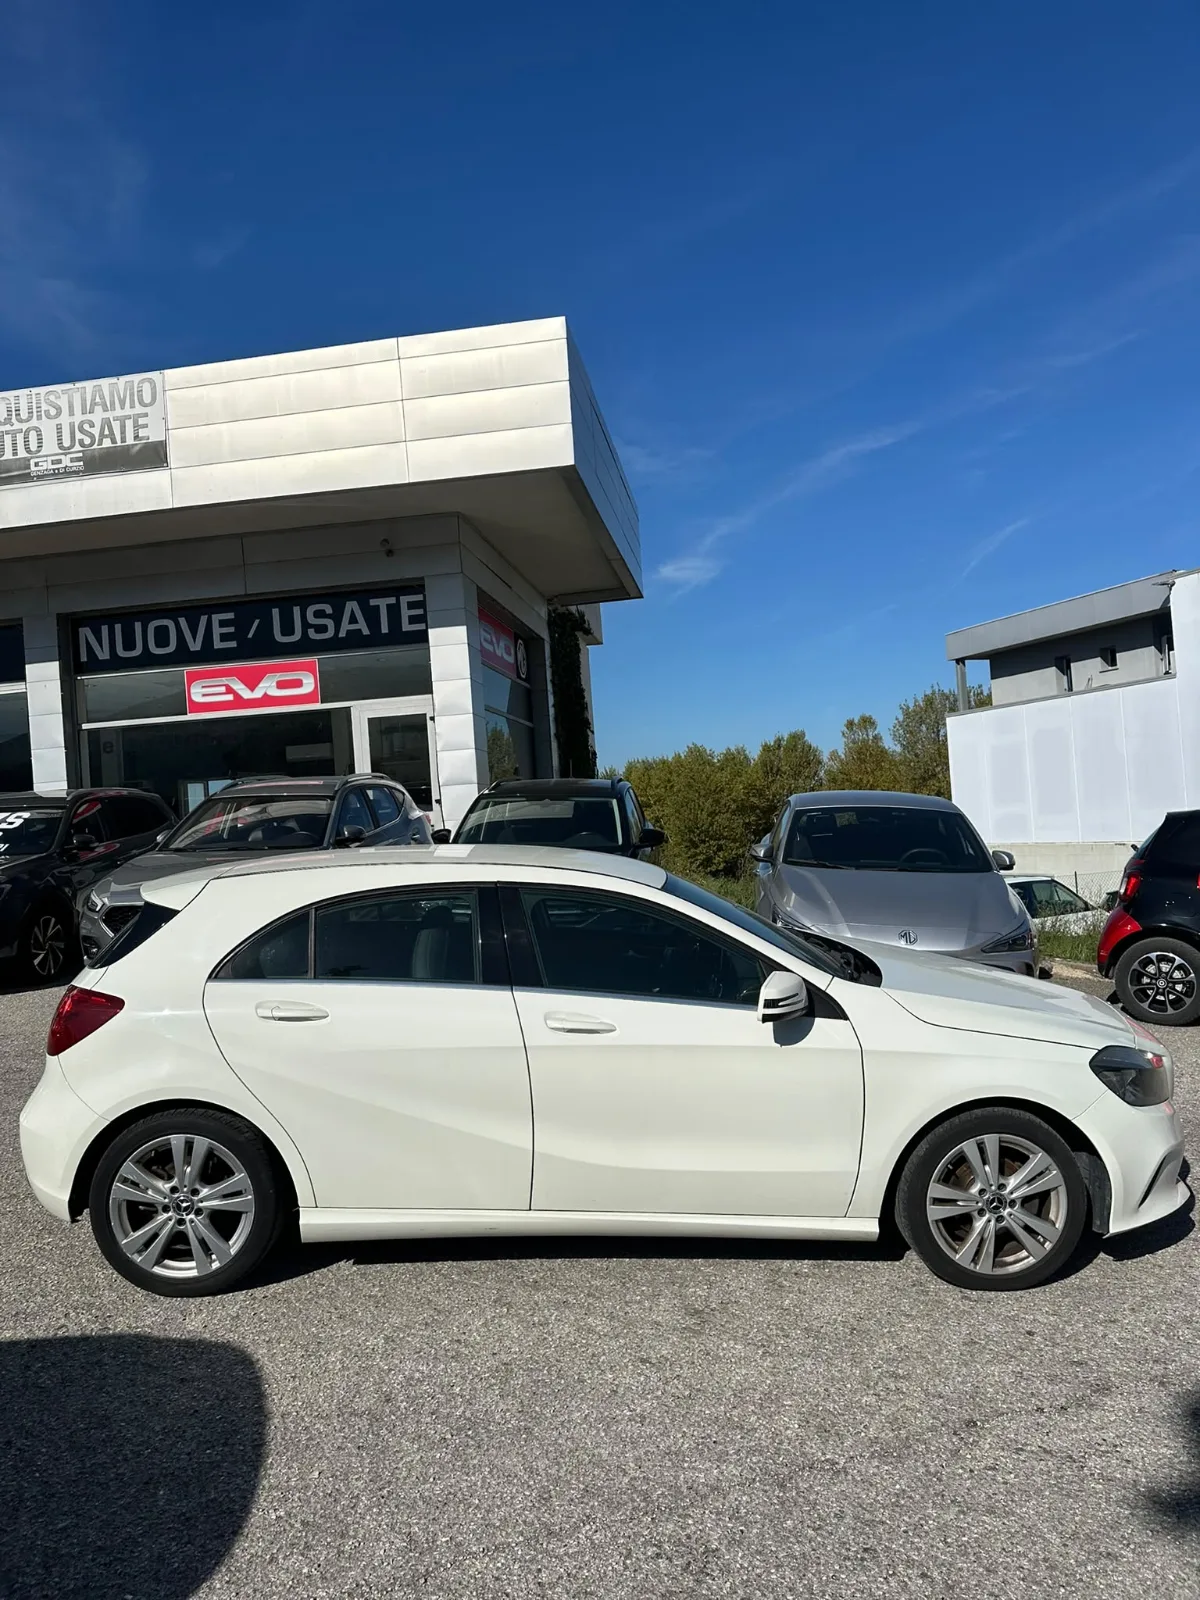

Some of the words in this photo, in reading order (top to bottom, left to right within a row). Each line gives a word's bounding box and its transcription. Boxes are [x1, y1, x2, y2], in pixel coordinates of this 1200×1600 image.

[0, 377, 157, 427] QUISTIAMO
[0, 426, 43, 458] TO
[56, 412, 150, 451] USATE
[30, 452, 84, 471] GDC
[78, 612, 238, 662] NUOVE
[271, 594, 427, 643] USATE
[480, 621, 515, 664] EVO
[190, 670, 315, 702] EVO
[899, 930, 917, 945] MG
